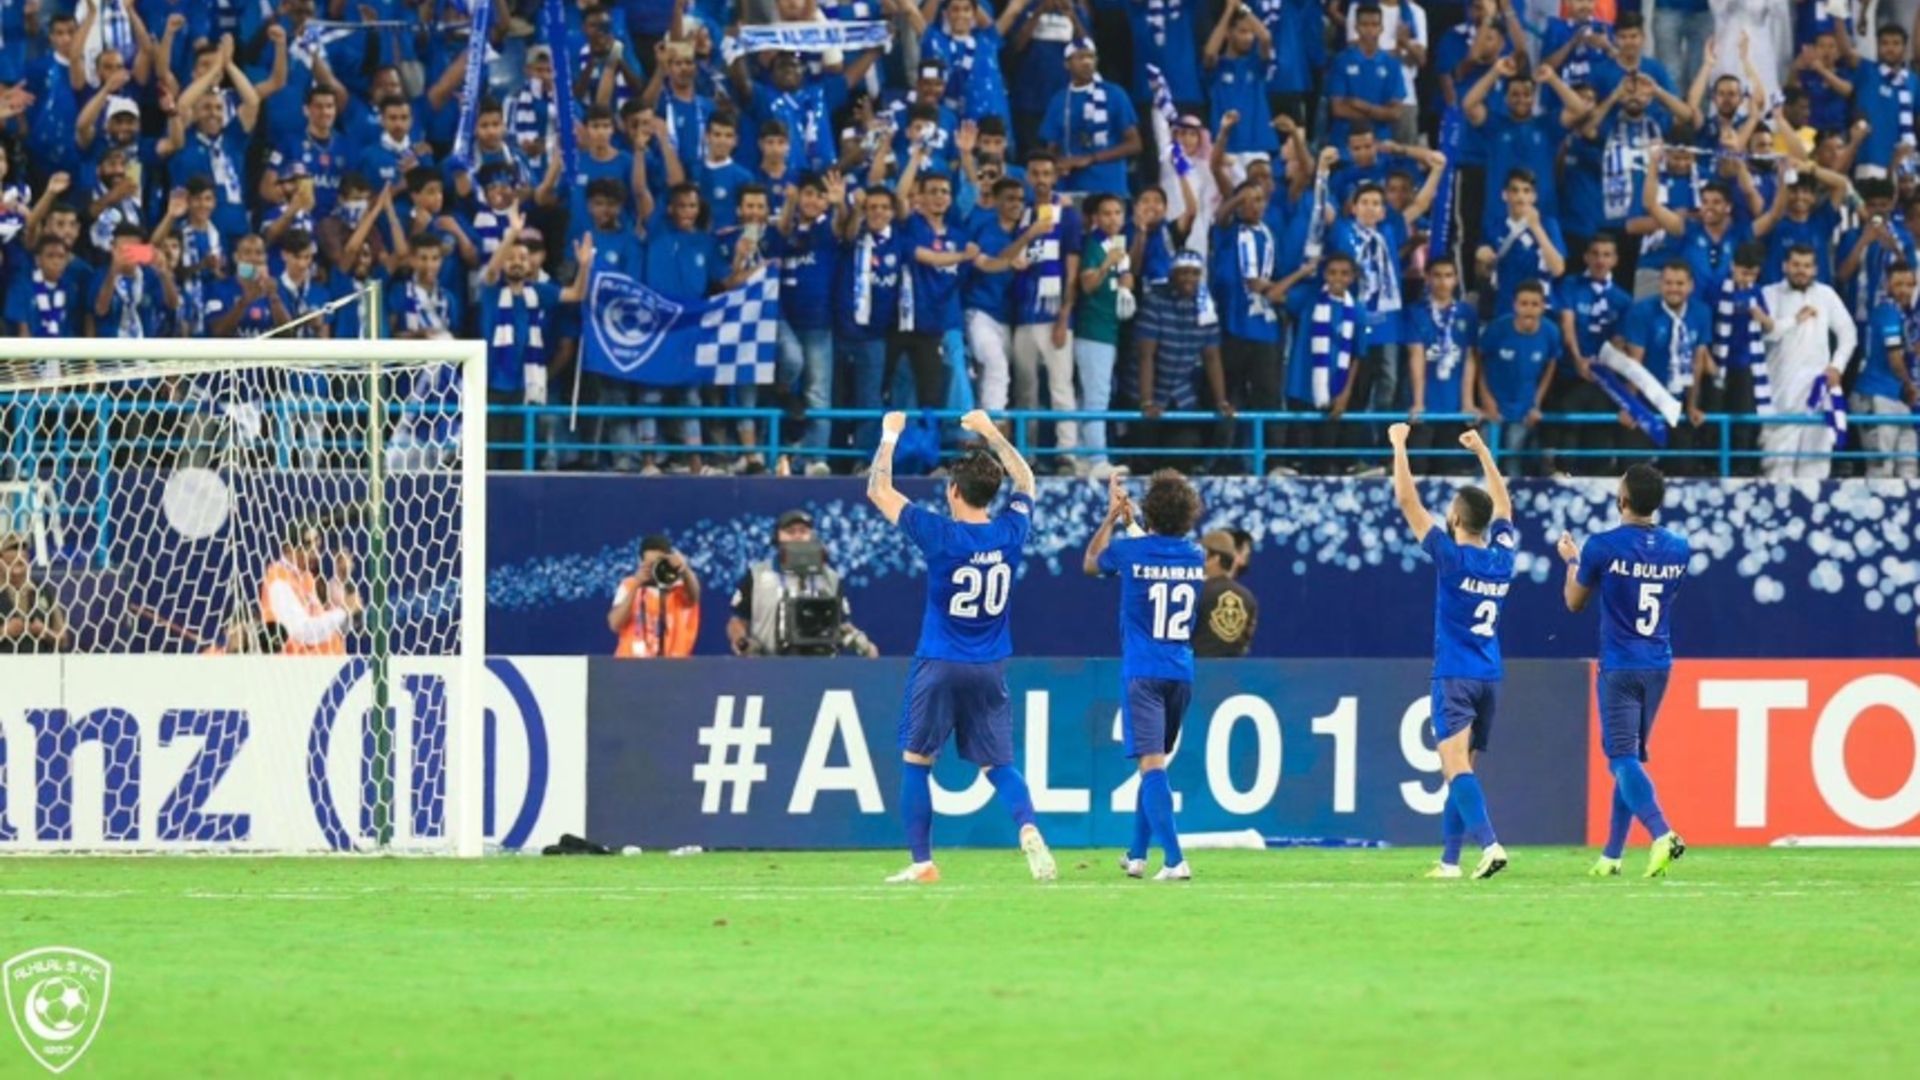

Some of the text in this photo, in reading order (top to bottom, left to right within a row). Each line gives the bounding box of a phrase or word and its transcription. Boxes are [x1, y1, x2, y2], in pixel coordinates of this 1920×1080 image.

[949, 563, 1012, 618] 20
[1609, 558, 1631, 576] AL
[1148, 582, 1196, 640] 12
[1469, 599, 1498, 637] 2
[1635, 582, 1664, 636] 5
[0, 707, 251, 842] nz
[1697, 673, 1920, 831] TO
